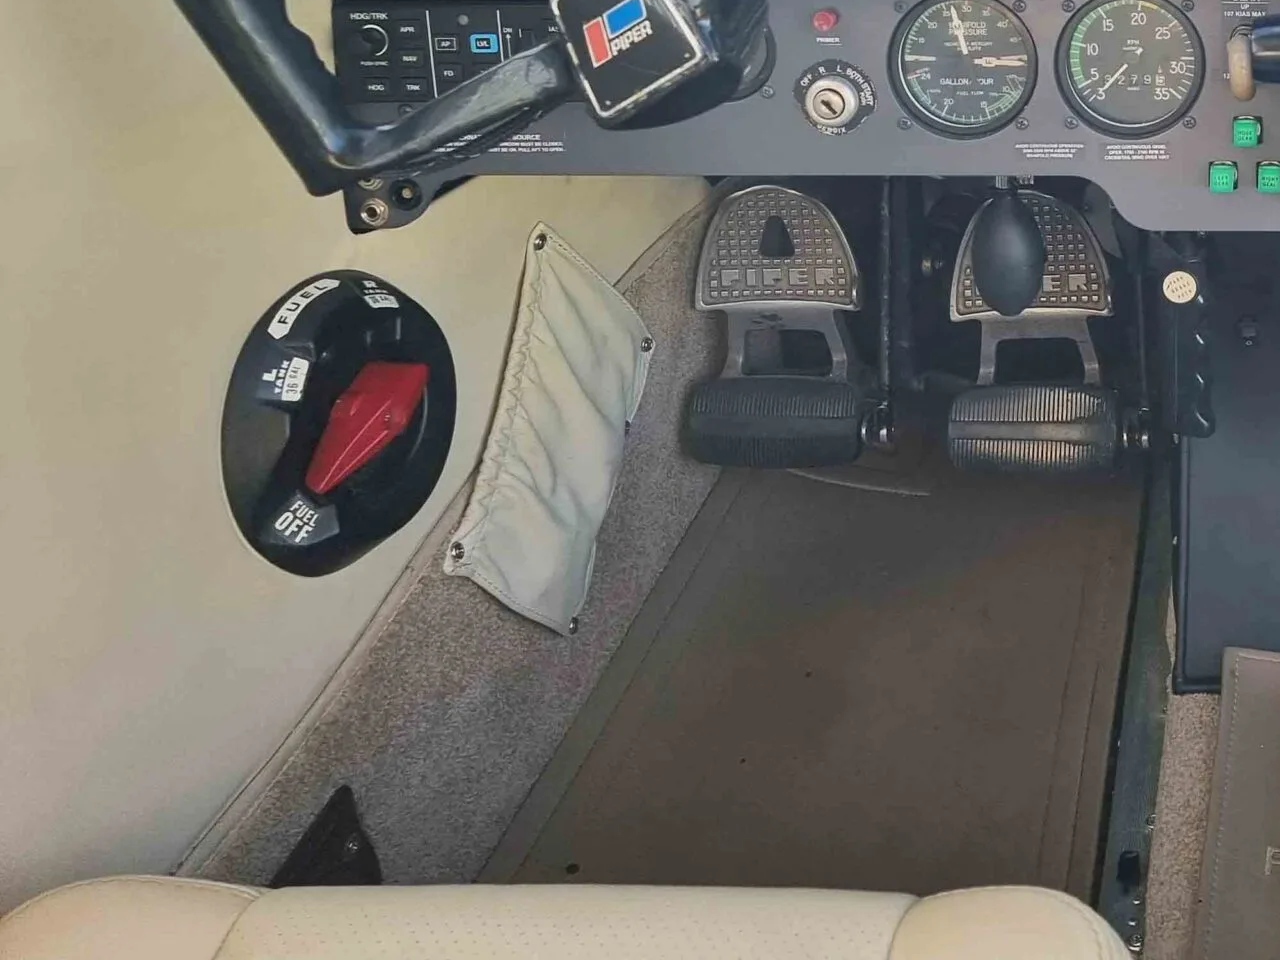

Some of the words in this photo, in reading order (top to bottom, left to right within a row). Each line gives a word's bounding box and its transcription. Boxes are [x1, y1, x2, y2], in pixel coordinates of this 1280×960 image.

[1131, 12, 1147, 24] 20
[1103, 19, 1114, 31] 15
[610, 20, 652, 57] PIPER
[1155, 27, 1171, 39] 25
[1087, 43, 1099, 55] 10
[1170, 62, 1186, 73] 30
[1154, 88, 1170, 99] 35
[720, 268, 834, 287] PIPER
[278, 283, 330, 325] FUEL
[290, 500, 319, 526] FUEL
[274, 512, 314, 543] OFF
